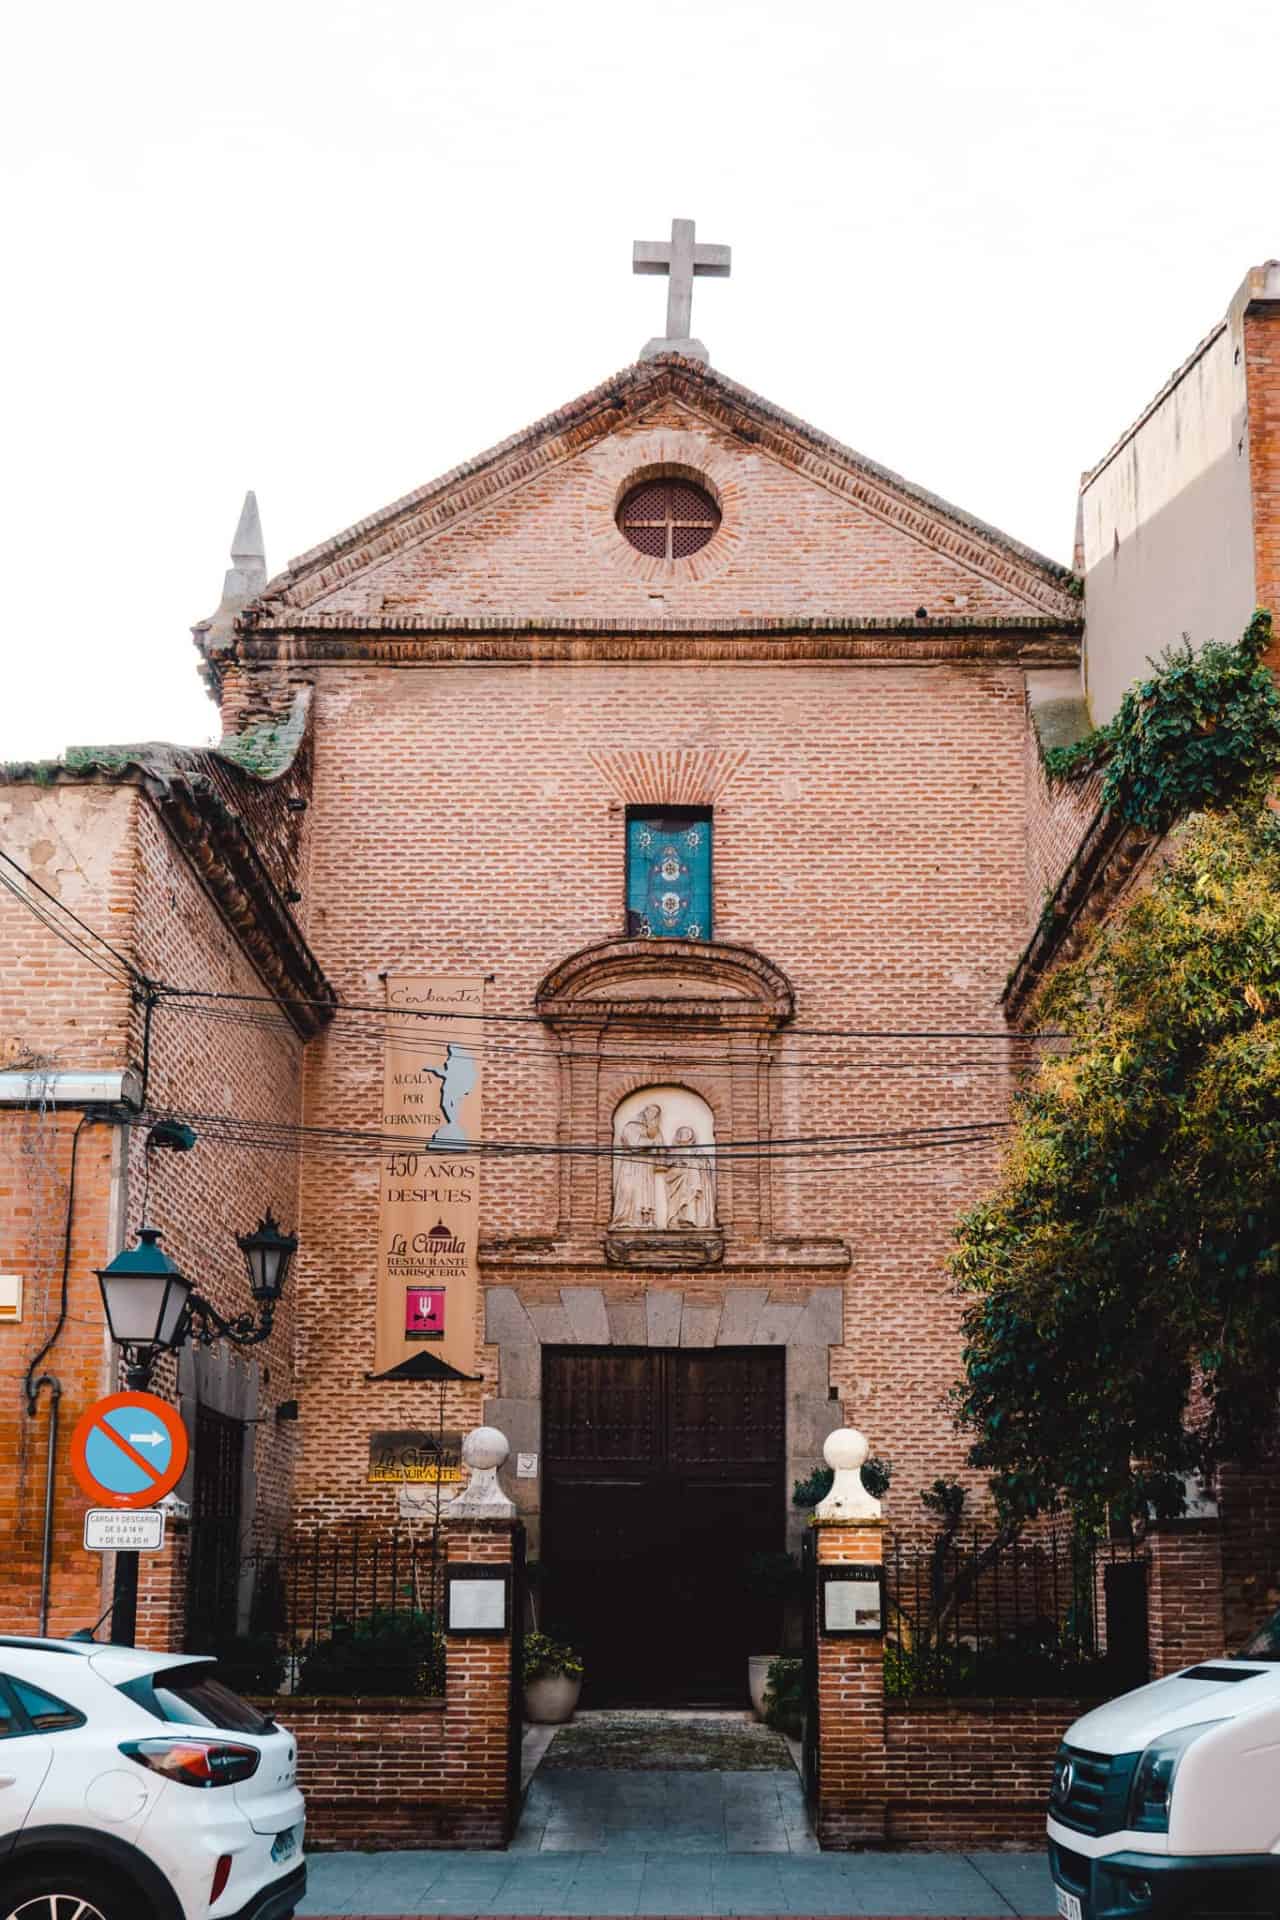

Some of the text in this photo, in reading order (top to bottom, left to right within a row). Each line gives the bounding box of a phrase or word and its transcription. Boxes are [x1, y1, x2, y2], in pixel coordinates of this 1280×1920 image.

[403, 1093, 424, 1105] POR
[384, 1114, 441, 1125] CERVANTES
[386, 1152, 476, 1178] 450 AÑOS
[387, 1232, 408, 1256] La
[387, 1257, 468, 1266] RESTAURANTE
[374, 1469, 457, 1479] RESTAURANTE
[104, 1525, 114, 1533] DE
[105, 1536, 114, 1545] DE
